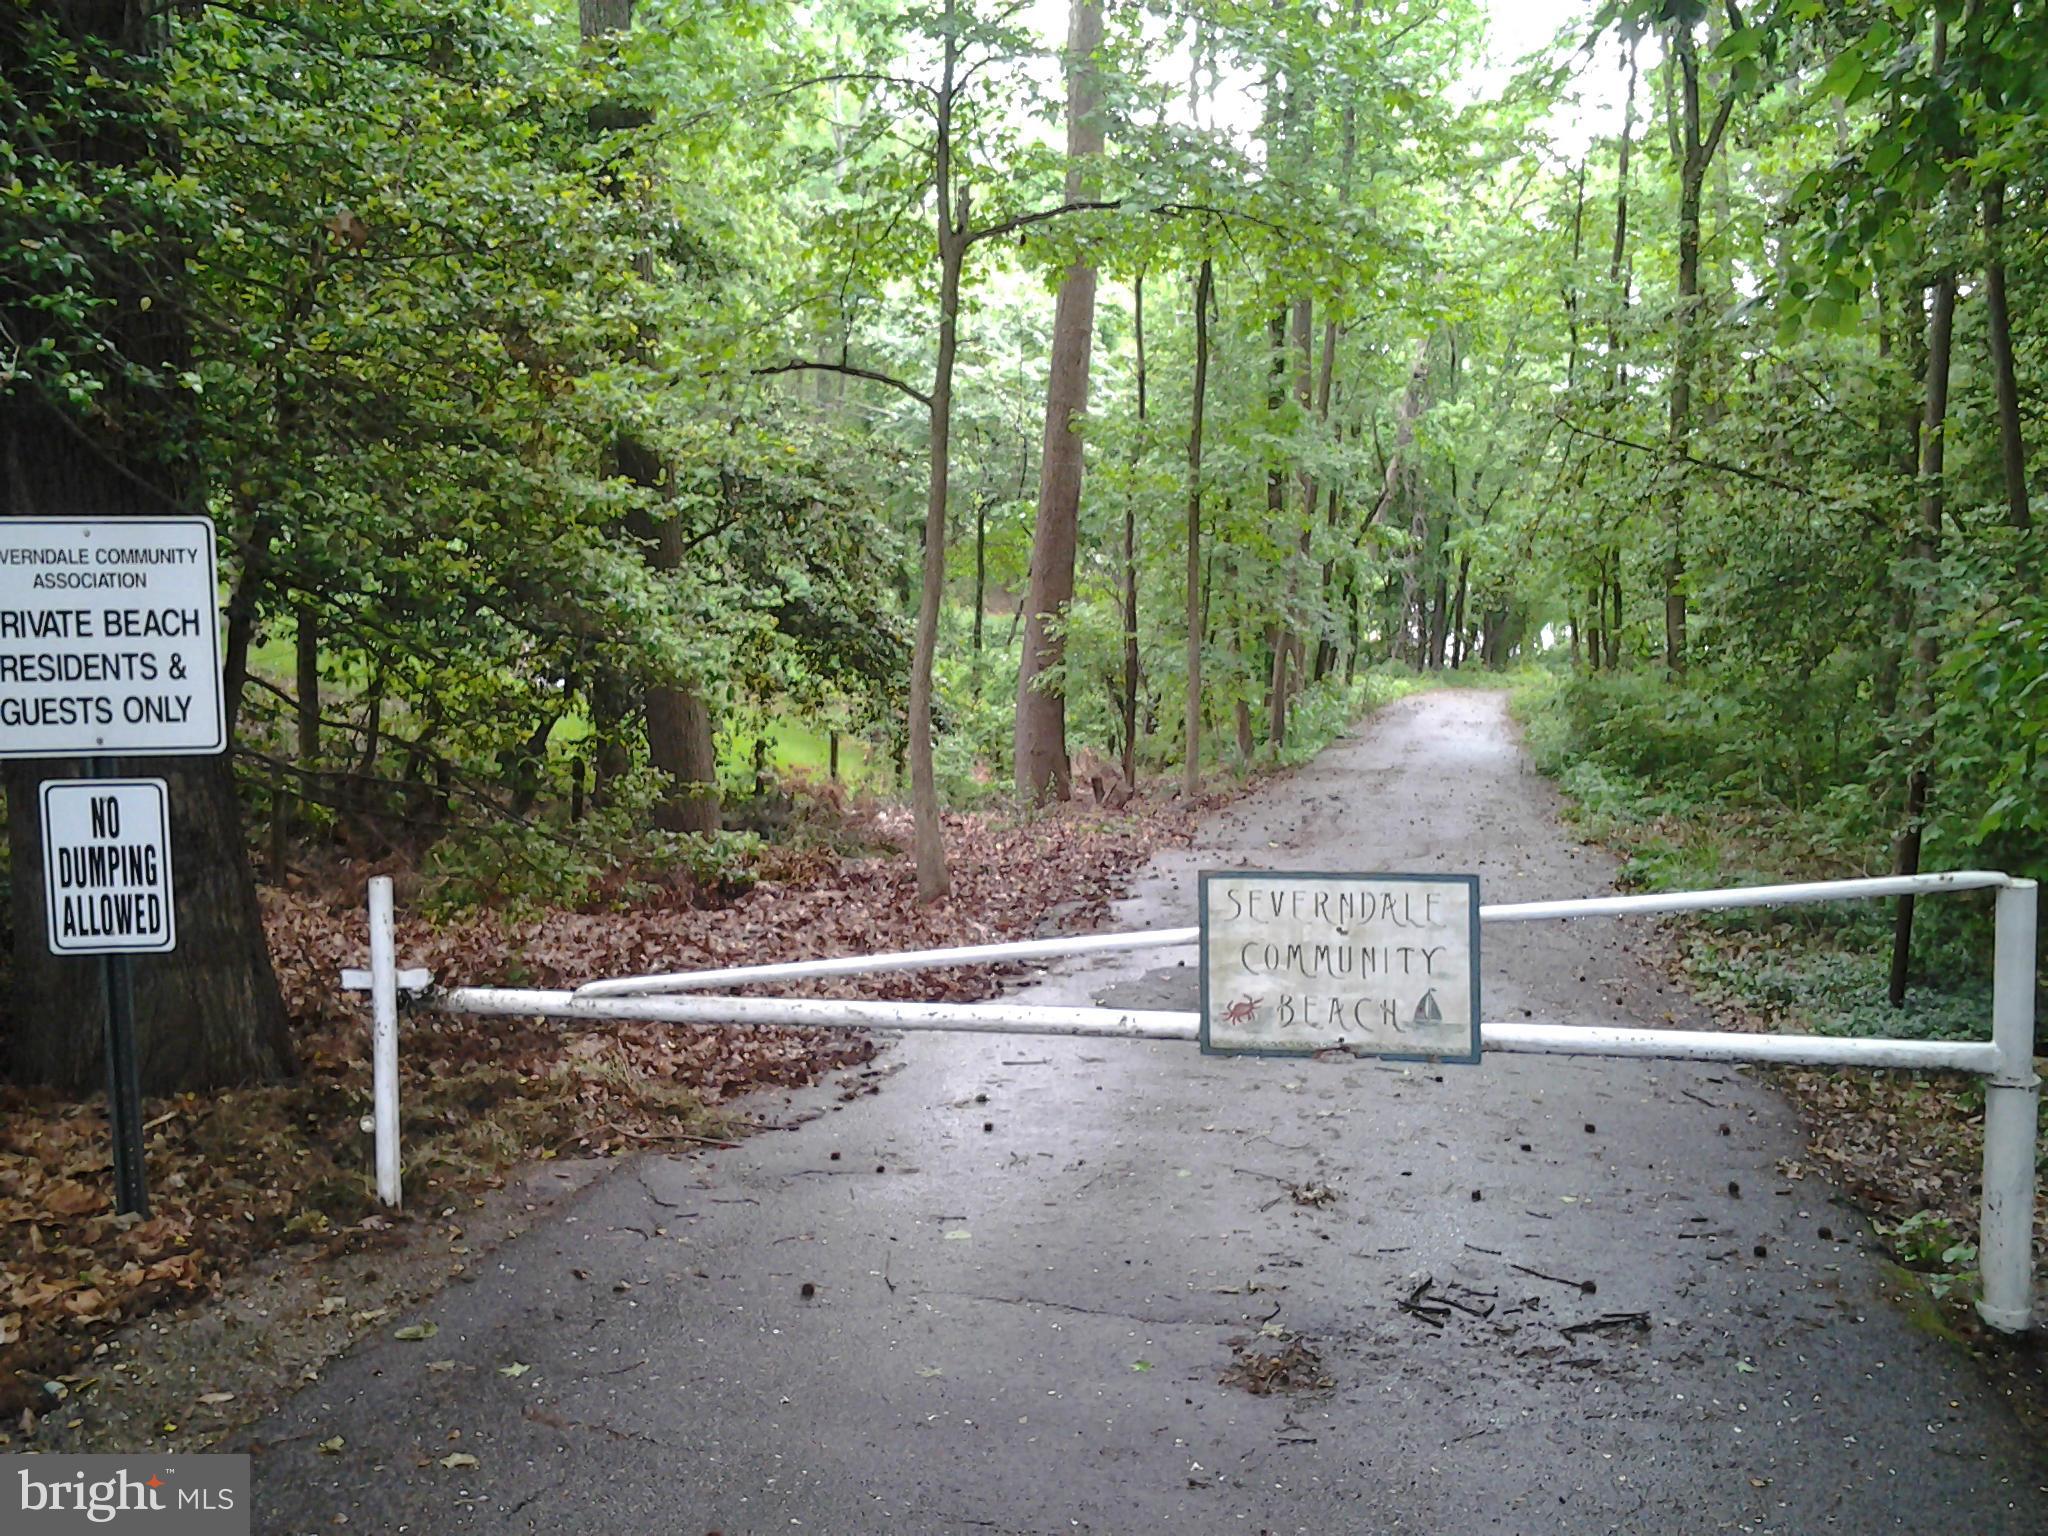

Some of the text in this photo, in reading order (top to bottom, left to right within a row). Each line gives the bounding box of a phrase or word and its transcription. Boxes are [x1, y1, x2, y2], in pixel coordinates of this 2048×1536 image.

[95, 548, 198, 565] COMMUNITY
[33, 572, 147, 589] ASSOCIATION
[103, 608, 200, 637] BEACH
[0, 652, 187, 682] RESIDENTS &
[0, 695, 192, 725] GUESTS ONLY
[90, 796, 120, 839] NO
[58, 844, 158, 888] DUMPING
[63, 893, 161, 937] ALLOWED
[1224, 888, 1447, 928] SEVERNDALE
[1241, 942, 1446, 979] COMMUNITY
[1277, 994, 1406, 1033] BEACH
